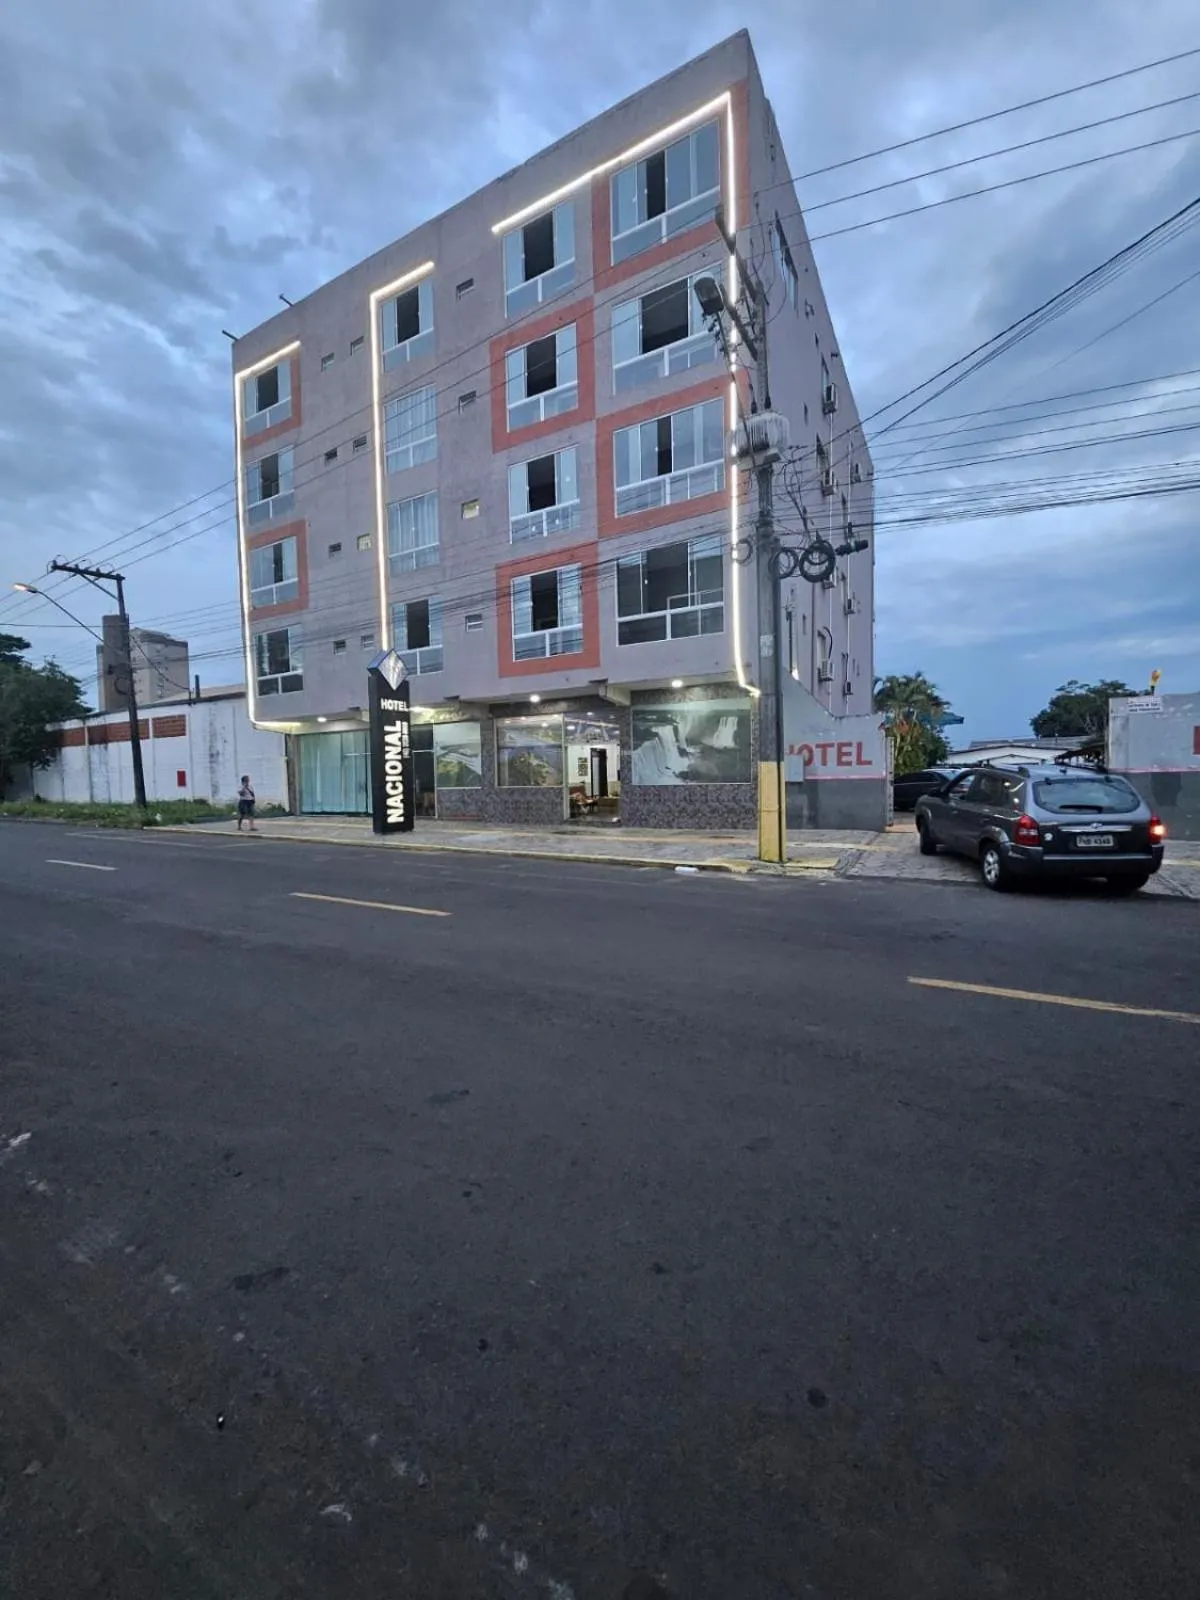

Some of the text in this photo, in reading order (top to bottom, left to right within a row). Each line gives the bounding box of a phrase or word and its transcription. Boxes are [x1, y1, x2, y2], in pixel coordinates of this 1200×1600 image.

[381, 698, 409, 712] HOTEL
[787, 741, 873, 767] OTEL
[383, 720, 405, 824] NACIONAL
